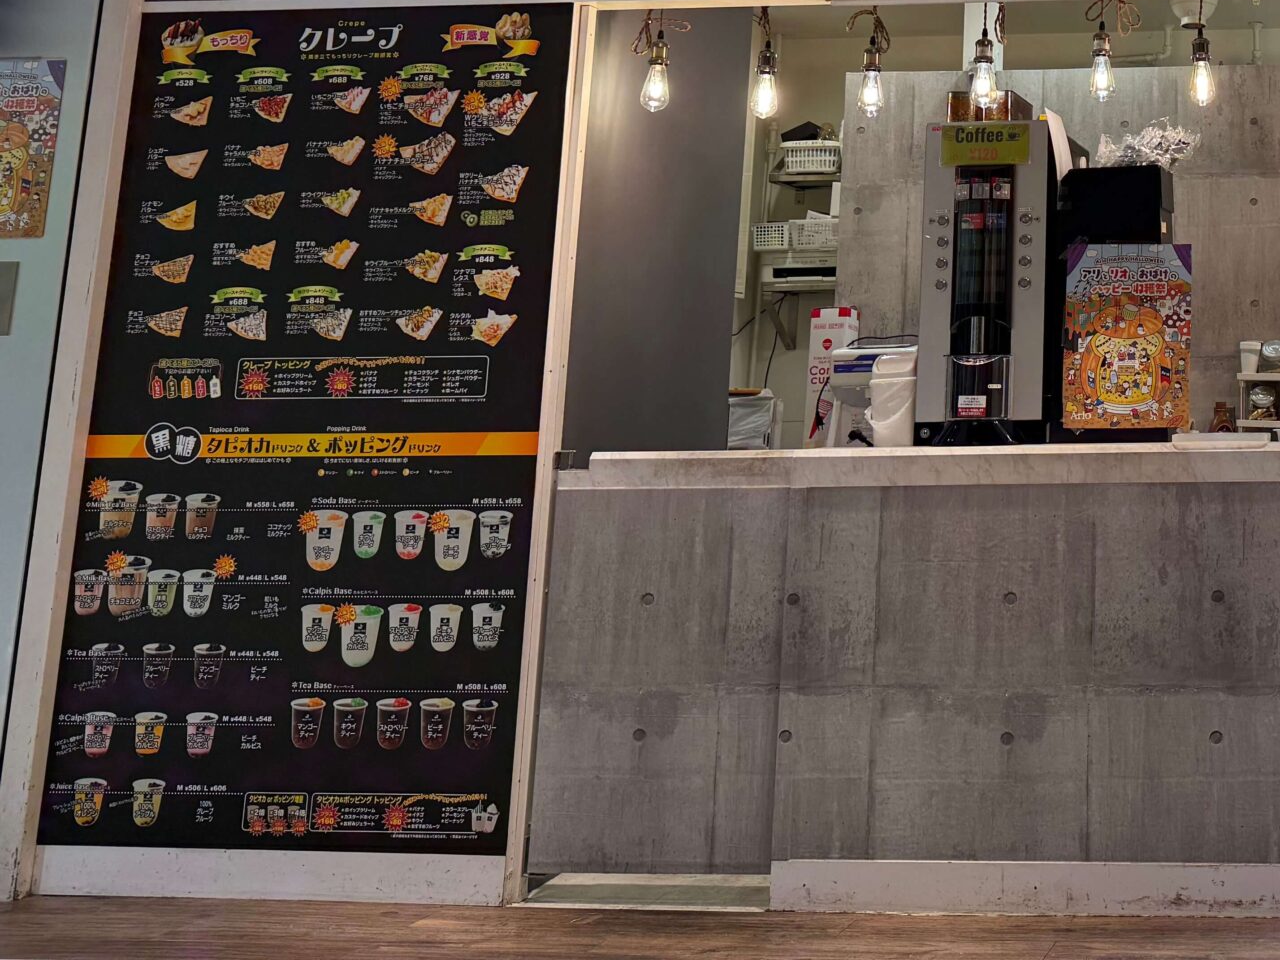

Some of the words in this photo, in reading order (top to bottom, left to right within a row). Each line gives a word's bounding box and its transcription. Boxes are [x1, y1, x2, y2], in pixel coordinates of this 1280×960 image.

[210, 34, 249, 47] もっちり
[299, 24, 403, 52] クレープ
[455, 30, 489, 41] 新感覚
[955, 127, 1003, 143] Coffee
[243, 361, 272, 369] クレープ
[275, 361, 310, 369] トッピング
[151, 429, 196, 457] 黒糖
[207, 436, 303, 454] タピオカドリンク
[307, 439, 320, 452] &
[325, 436, 442, 454] ポッピングドリンク
